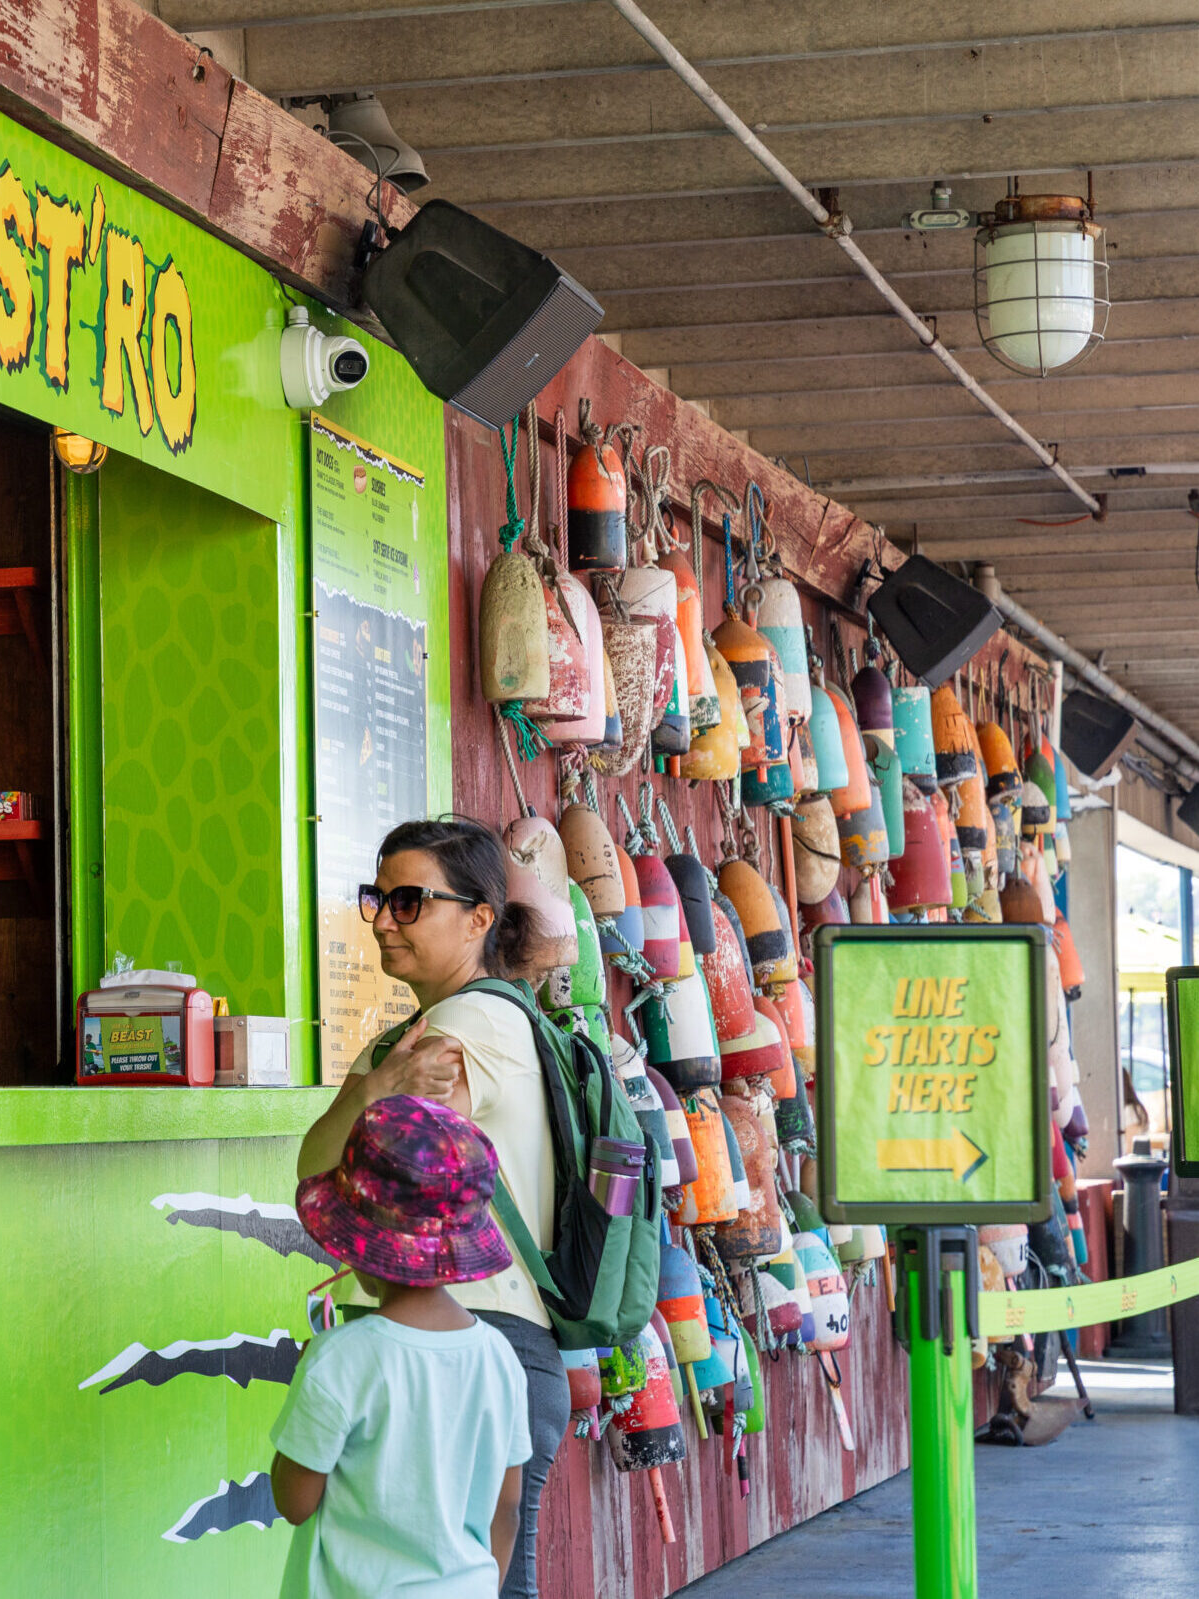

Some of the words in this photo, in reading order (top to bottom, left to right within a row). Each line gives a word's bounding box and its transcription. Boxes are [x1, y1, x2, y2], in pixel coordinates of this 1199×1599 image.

[892, 977, 968, 1019] LINE
[110, 1029, 154, 1043] BEAST
[863, 1025, 1001, 1067] STARTS
[111, 1056, 128, 1064] PLEASE
[147, 1054, 158, 1062] OUT
[119, 1064, 133, 1072] YOUR
[887, 1073, 978, 1115] HERE
